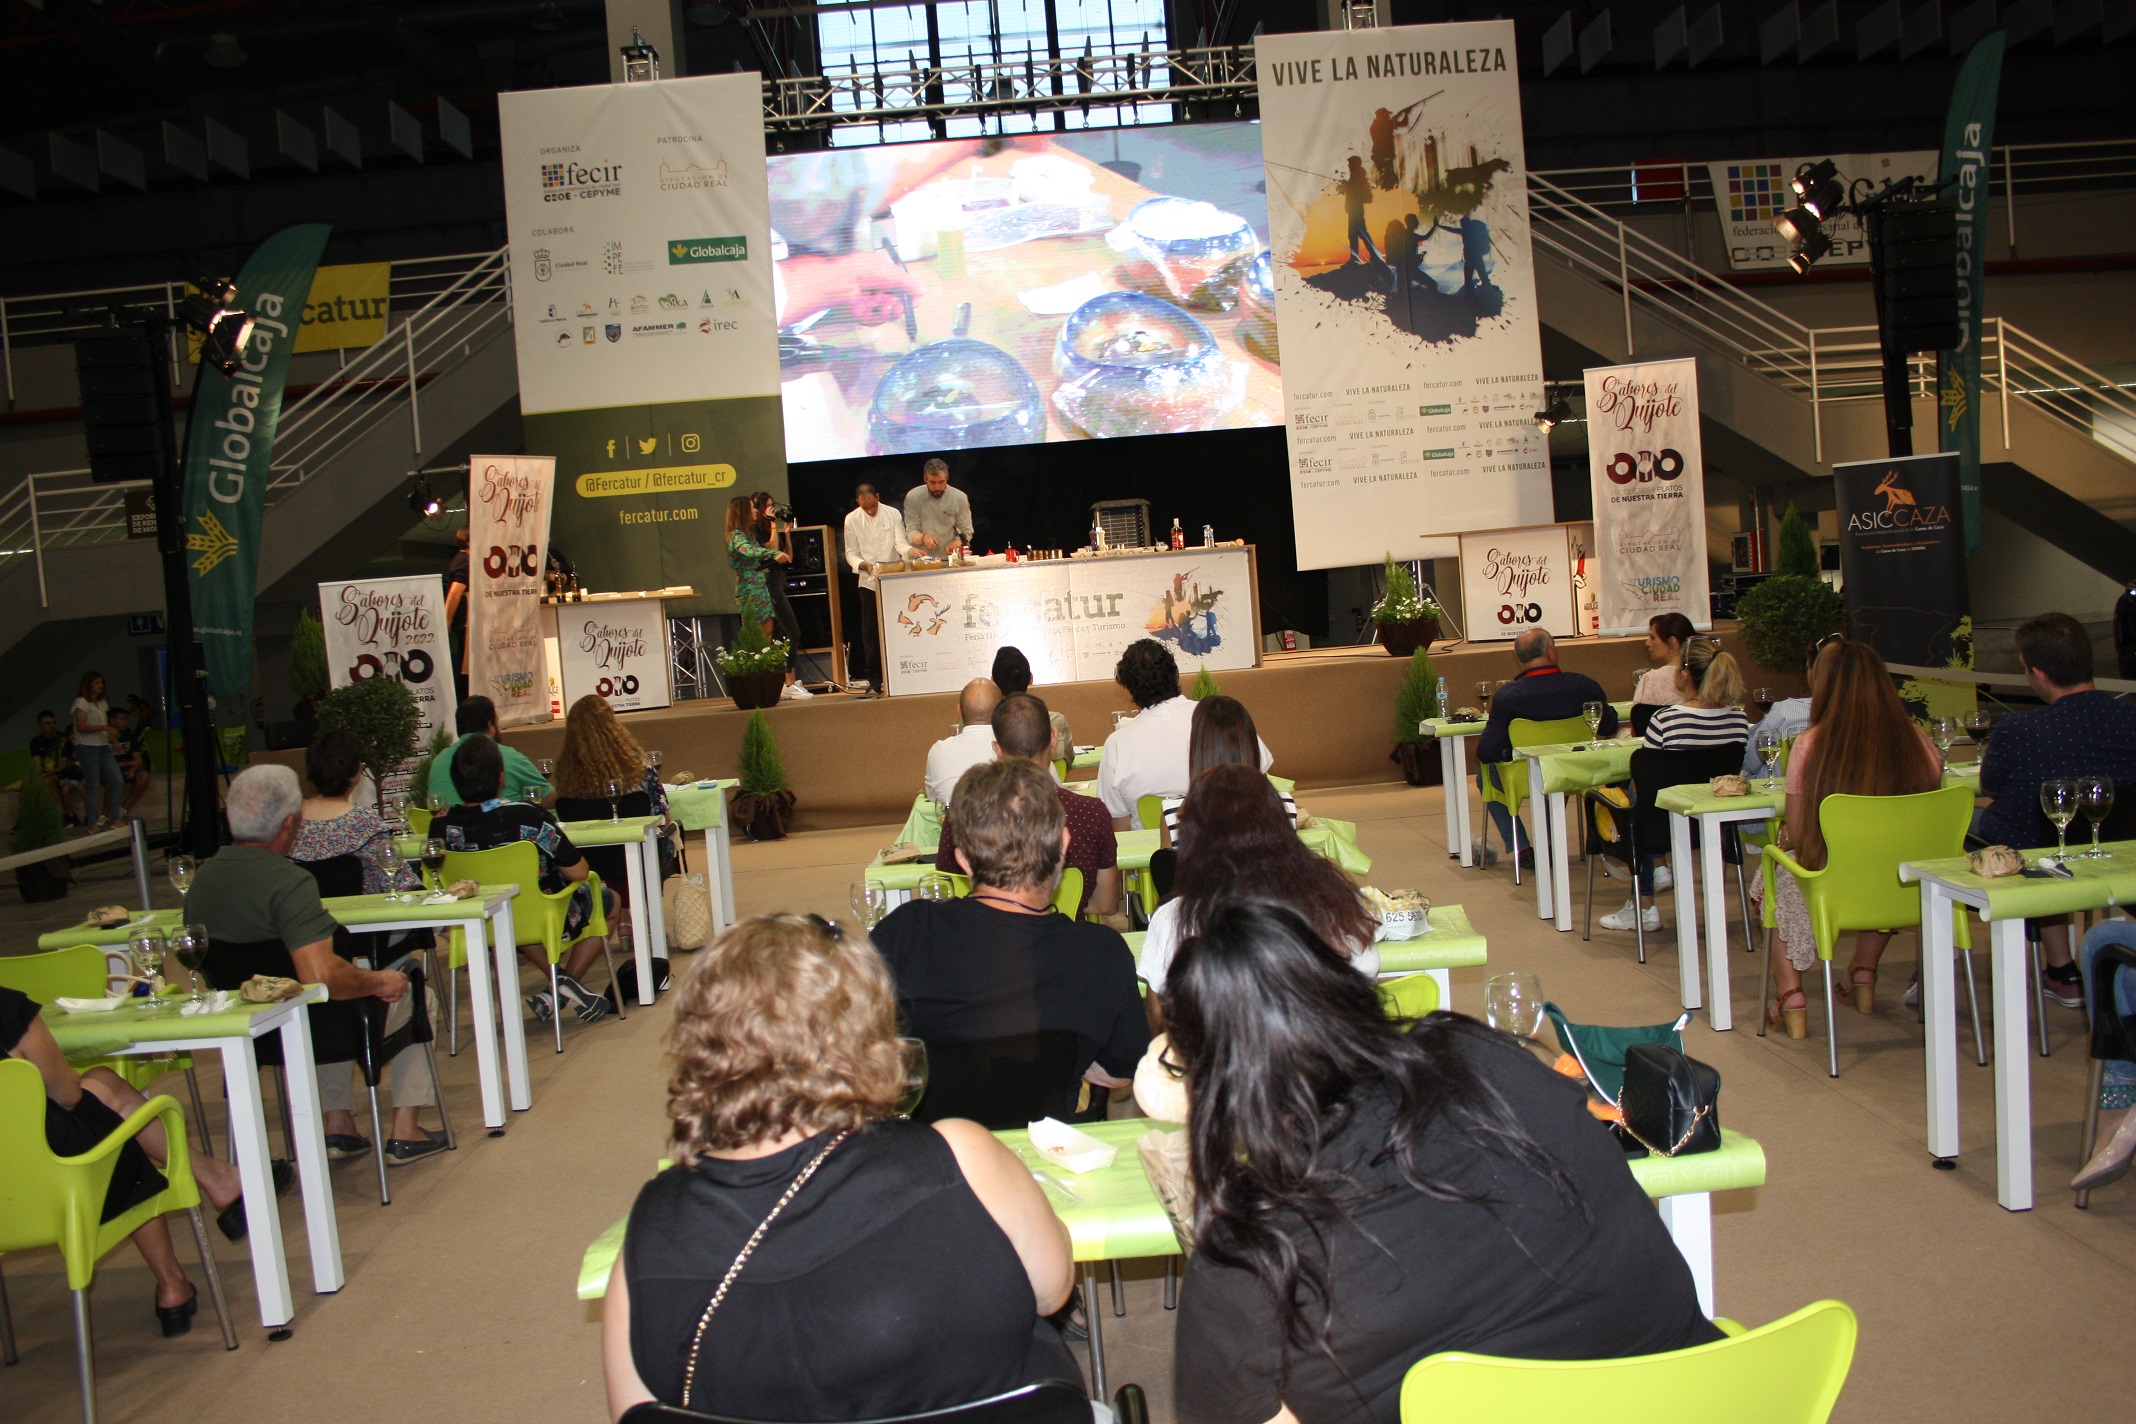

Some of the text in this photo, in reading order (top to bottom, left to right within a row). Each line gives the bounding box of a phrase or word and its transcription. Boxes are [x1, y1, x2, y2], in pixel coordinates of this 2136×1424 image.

[1272, 48, 1507, 86] VIVE LA NATURALEZA
[657, 135, 703, 144] PATROCINA
[540, 145, 581, 155] ORGANIZA
[566, 158, 622, 186] fecir
[660, 180, 728, 191] CIUDAD REAL
[580, 187, 621, 199] CEPYME
[532, 227, 574, 237] COLABORA
[690, 244, 746, 258] Globalcaja
[301, 296, 386, 326] catur
[632, 324, 674, 332] AFAMMER
[714, 319, 738, 330] irec
[1424, 380, 1463, 389] fercatur.com
[1476, 374, 1539, 385] VIVE LA NATURALEZA
[1293, 391, 1333, 400] fercatur.com
[1346, 388, 1360, 396] VIVE
[1371, 384, 1410, 393] NATURALEZA
[1596, 376, 1678, 413] Sabores del
[1306, 413, 1328, 423] fecir
[1613, 395, 1684, 434] Quijote
[1427, 424, 1466, 433] fercatur.com
[1479, 421, 1493, 429] VIVE
[1495, 420, 1502, 428] LA
[1297, 434, 1336, 444] fercatur.com
[1350, 432, 1364, 440] VIVE
[1375, 428, 1414, 438] NATURALEZA
[1309, 457, 1332, 467] fecir
[1482, 465, 1496, 473] VIVE
[1507, 462, 1546, 471] NATURALEZA
[1353, 476, 1367, 484] VIVE
[1379, 472, 1418, 482] NATURALEZA
[1430, 469, 1469, 477] fercatur.com
[479, 464, 529, 503] Sabores
[586, 470, 726, 492] @Fercatur / @fercatur_cr
[1301, 479, 1340, 489] fercatur.com
[1622, 494, 1655, 502] NUESTRA
[1656, 492, 1683, 500] TIERRA
[620, 508, 698, 525] fercatur.com
[1848, 506, 1952, 531] ASICCAZA
[1619, 546, 1655, 554] CIUDAD
[1482, 548, 1547, 580] Sabores del
[1495, 565, 1552, 598] Quijote
[1641, 585, 1680, 594] CIUDAD
[1653, 592, 1680, 602] REAL
[335, 586, 425, 625] Sabores del
[355, 607, 431, 649] Quijote
[1092, 622, 1126, 631] Turismo
[580, 620, 643, 652] Sabores del
[489, 642, 517, 650] CIUDAD
[593, 638, 647, 671] Quijote
[512, 689, 532, 698] REAL
[1386, 912, 1404, 922] 625
